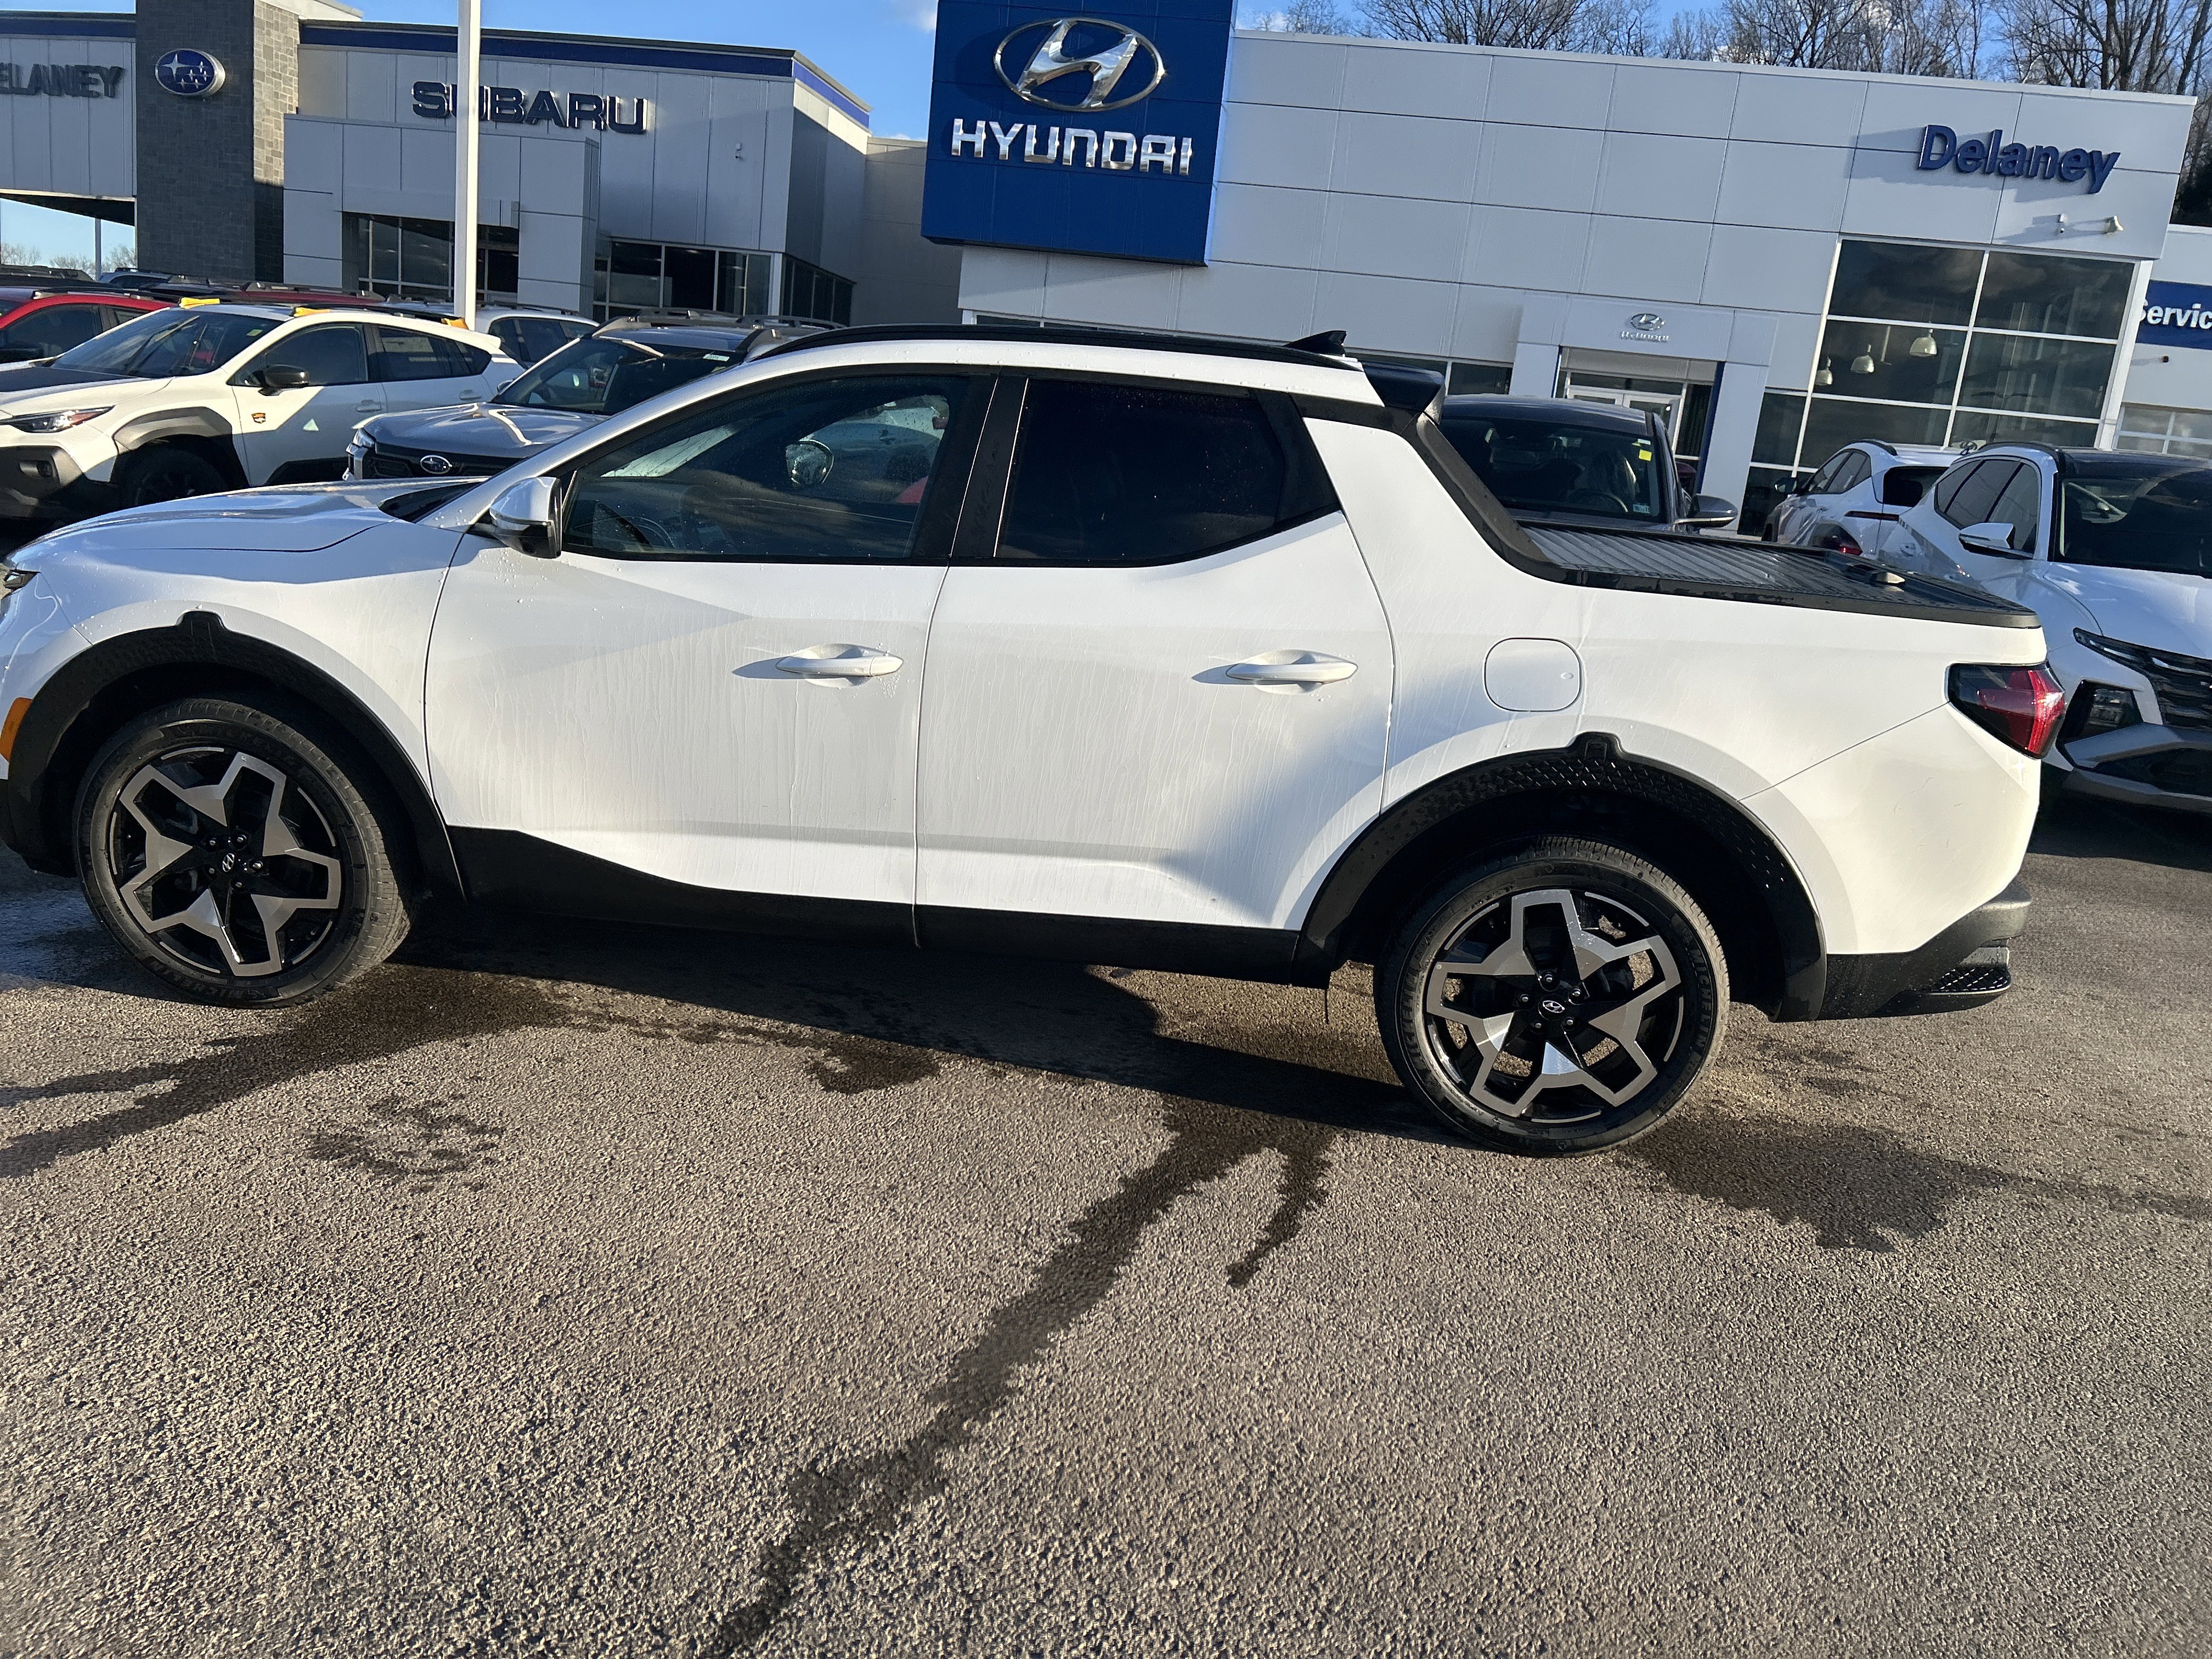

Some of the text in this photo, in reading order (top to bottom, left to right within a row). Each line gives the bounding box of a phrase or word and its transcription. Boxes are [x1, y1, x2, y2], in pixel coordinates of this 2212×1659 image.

[951, 118, 1193, 176] HYUNDAI
[1918, 124, 2121, 194] Delaney
[1690, 949, 1712, 1048] MICHELIN
